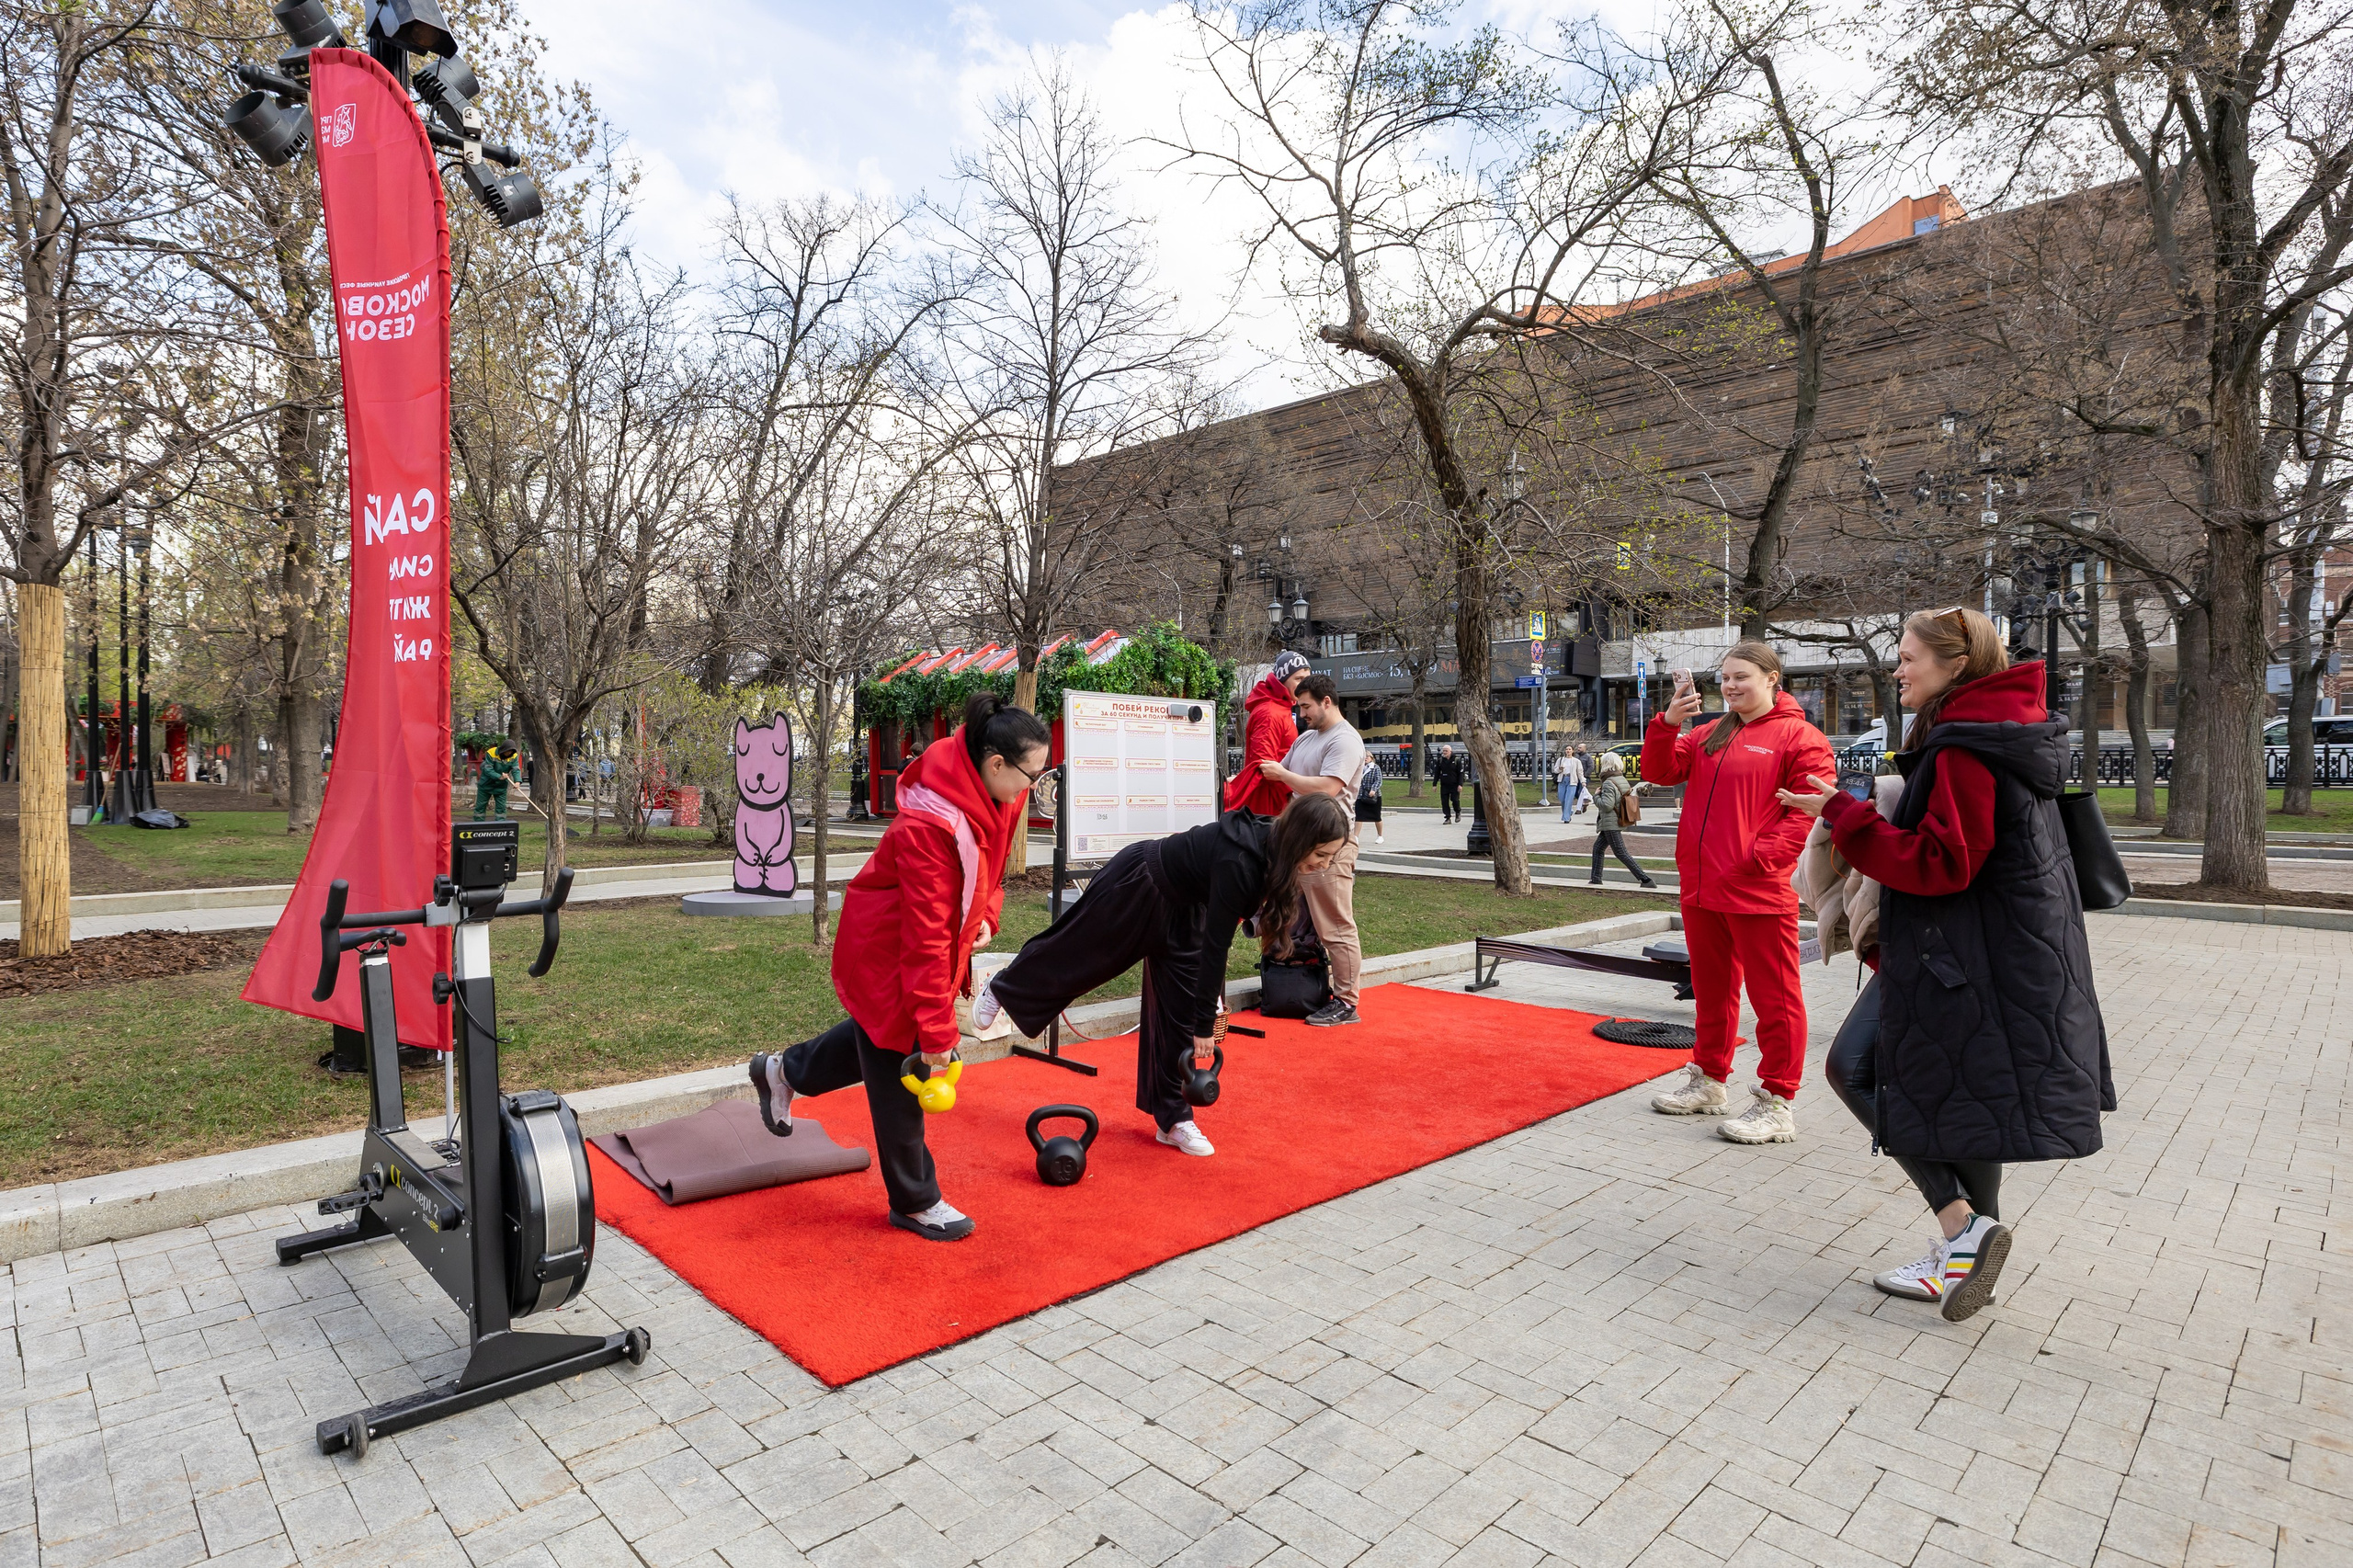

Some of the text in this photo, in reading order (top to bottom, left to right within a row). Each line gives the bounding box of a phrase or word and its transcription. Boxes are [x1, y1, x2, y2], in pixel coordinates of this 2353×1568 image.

[1112, 702, 1168, 714] ПОБЕЙ РЕКО
[1846, 778, 1865, 787] 13:44
[401, 1176, 439, 1221] concept 2
